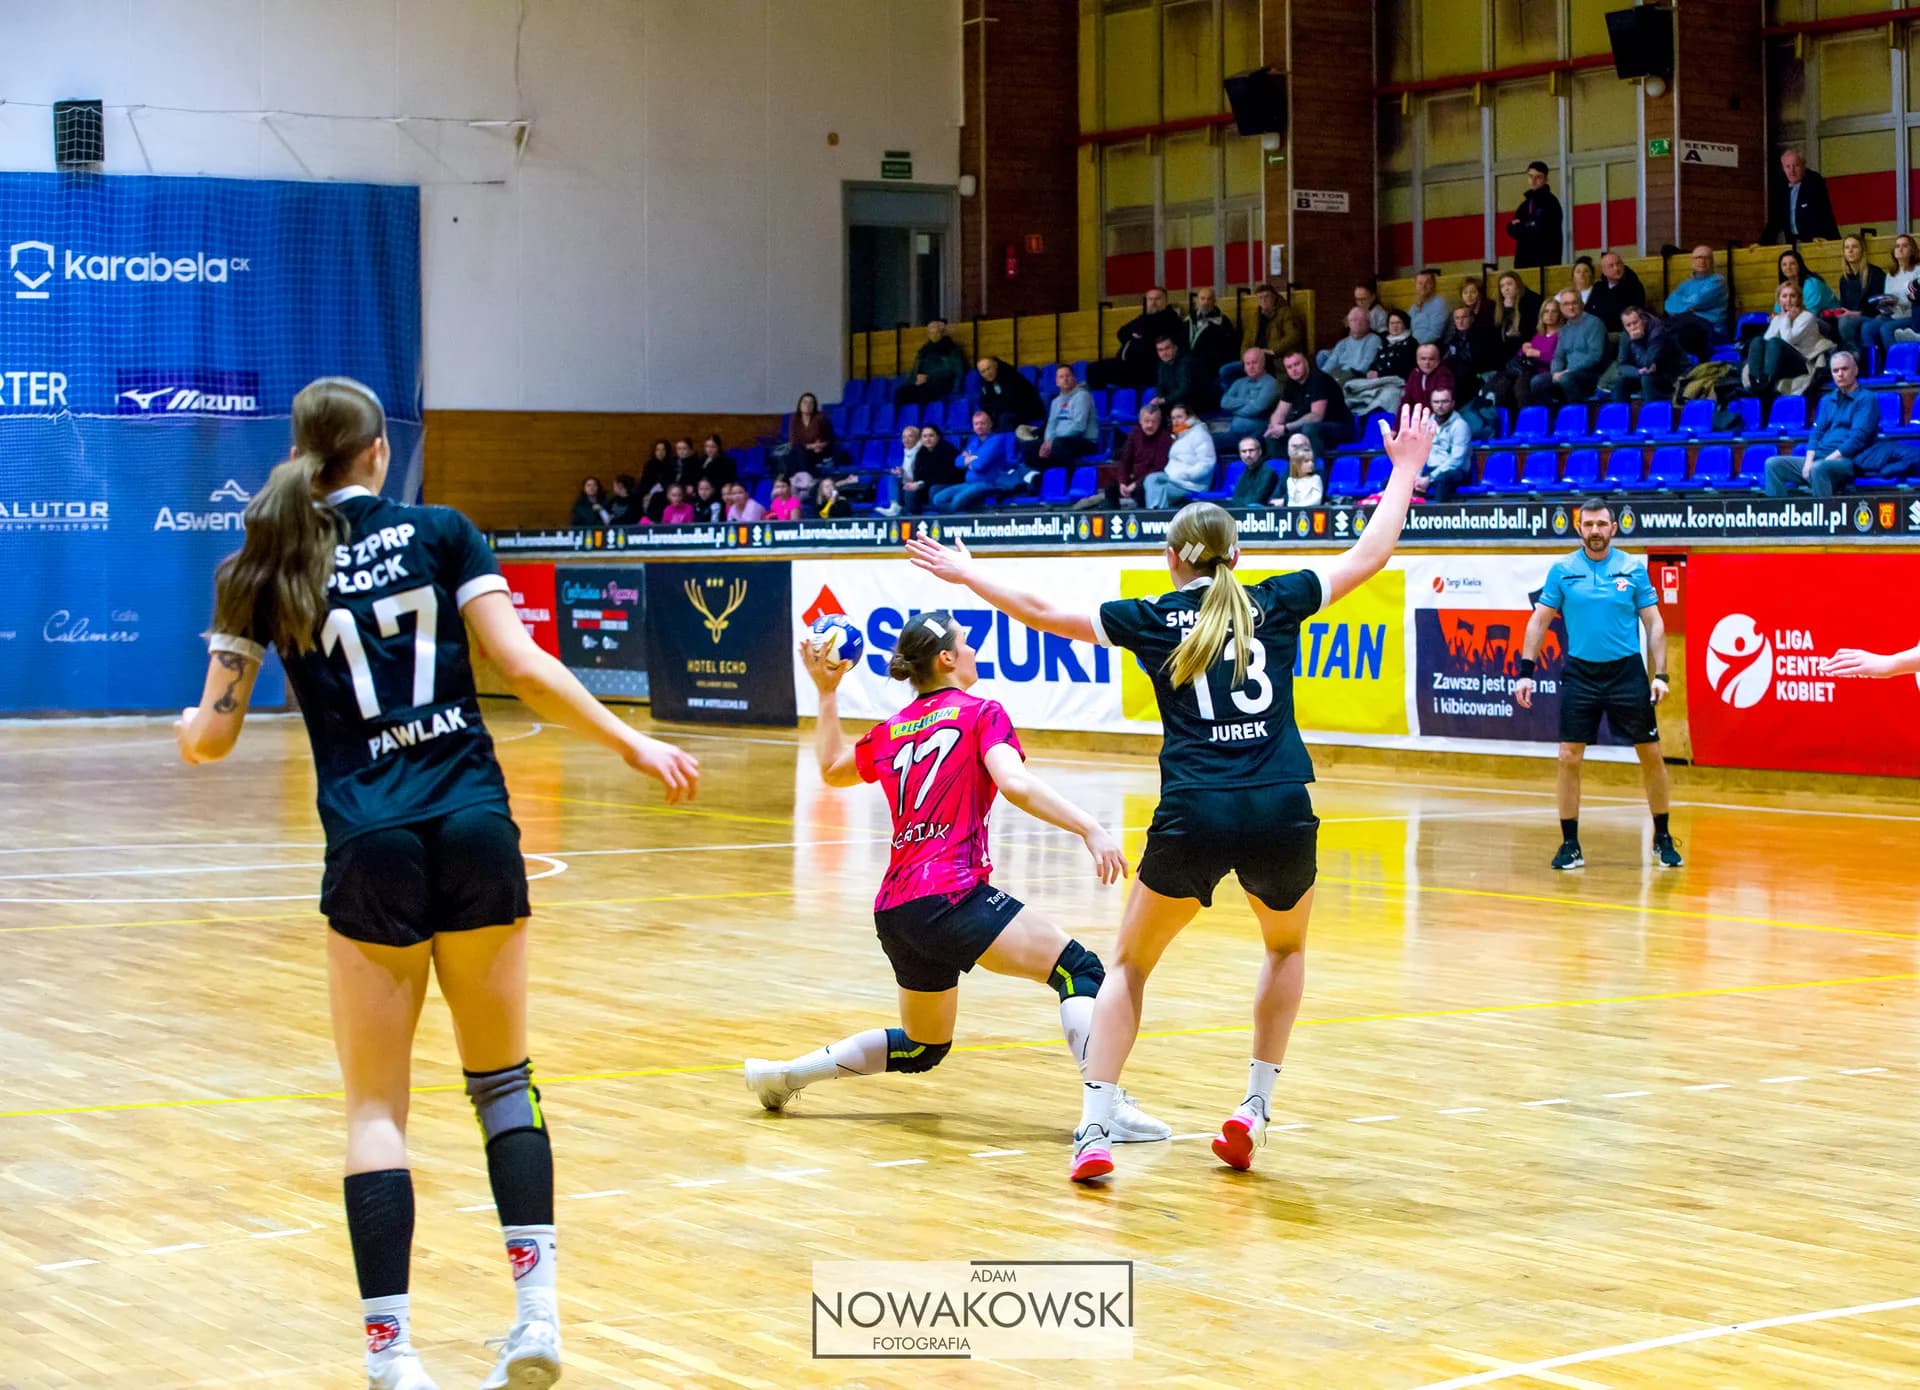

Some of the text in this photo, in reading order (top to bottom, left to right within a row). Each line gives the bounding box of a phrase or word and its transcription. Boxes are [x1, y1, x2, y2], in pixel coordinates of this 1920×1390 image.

[1683, 142, 1735, 152] SEKTOR
[1683, 149, 1703, 162] A
[1296, 198, 1311, 209] B
[65, 249, 250, 283] karabela CK
[1401, 507, 1547, 536] .koronahandball.pl
[1641, 502, 1847, 533] www.koronahandball.pl
[774, 522, 887, 545] www.koronahandball.pl
[943, 517, 1075, 545] www.koronahandball.pl
[43, 609, 140, 642] Calimero
[1775, 629, 1814, 650] LIGA
[320, 584, 438, 720] 17
[687, 660, 747, 674] HOTEL ECHO
[1433, 672, 1480, 691] Zawsze
[1482, 674, 1506, 695] jest
[1540, 680, 1556, 694] na
[1776, 680, 1836, 703] KOBIET
[1433, 697, 1513, 717] i kibicowanie
[367, 706, 468, 760] PAWLAK
[1208, 720, 1268, 742] JUREK
[892, 727, 963, 817] 17
